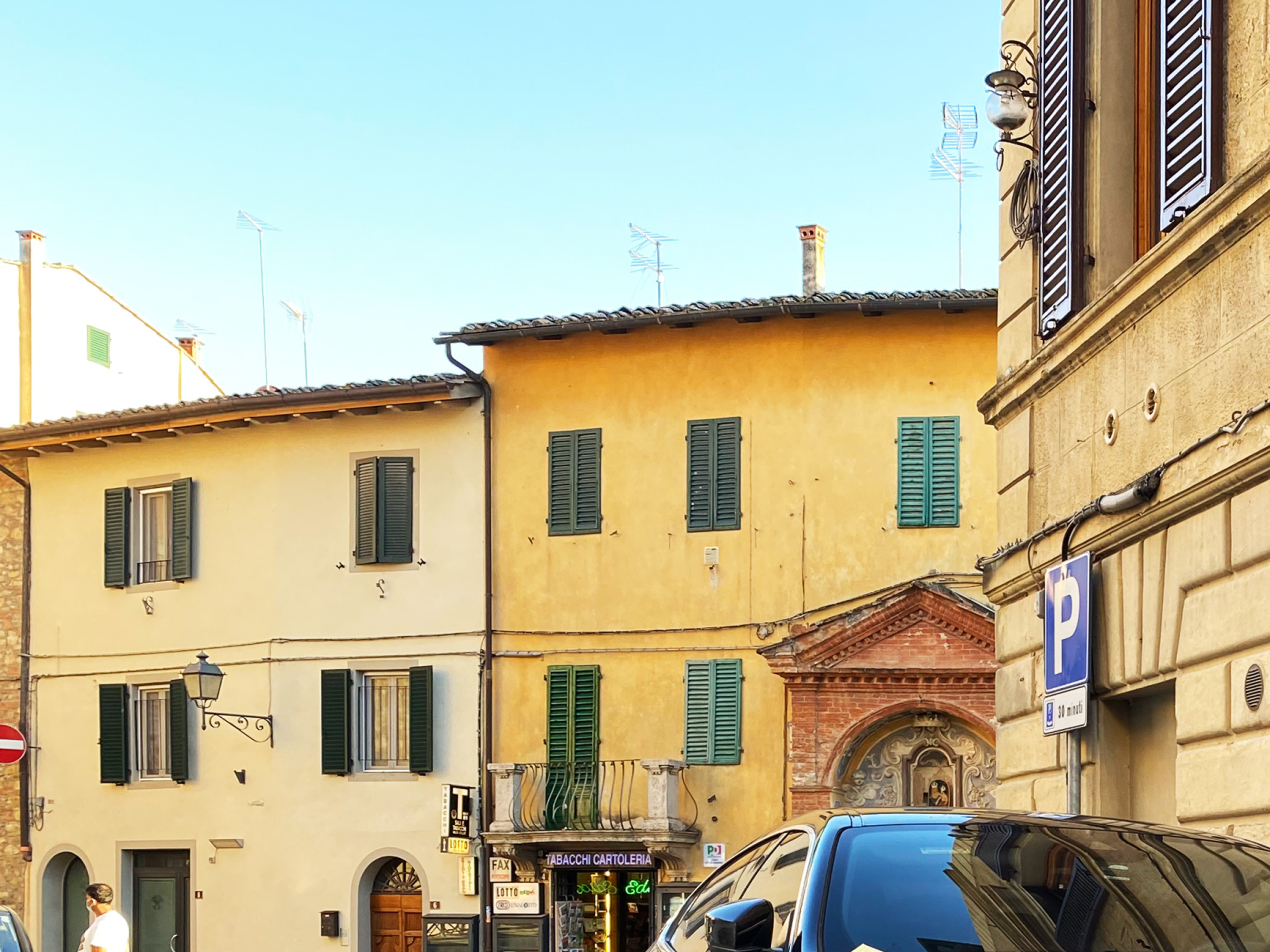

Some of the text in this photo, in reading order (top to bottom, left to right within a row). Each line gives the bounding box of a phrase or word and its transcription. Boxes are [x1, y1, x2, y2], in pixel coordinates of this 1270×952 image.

[1054, 576, 1080, 675] P
[1058, 700, 1083, 718] 30 minuti
[452, 787, 469, 820] T
[449, 839, 468, 850] LOTTO
[491, 859, 510, 871] FAX
[545, 852, 652, 866] TABACCHI CARTOLERIA
[496, 887, 519, 897] LOTTO
